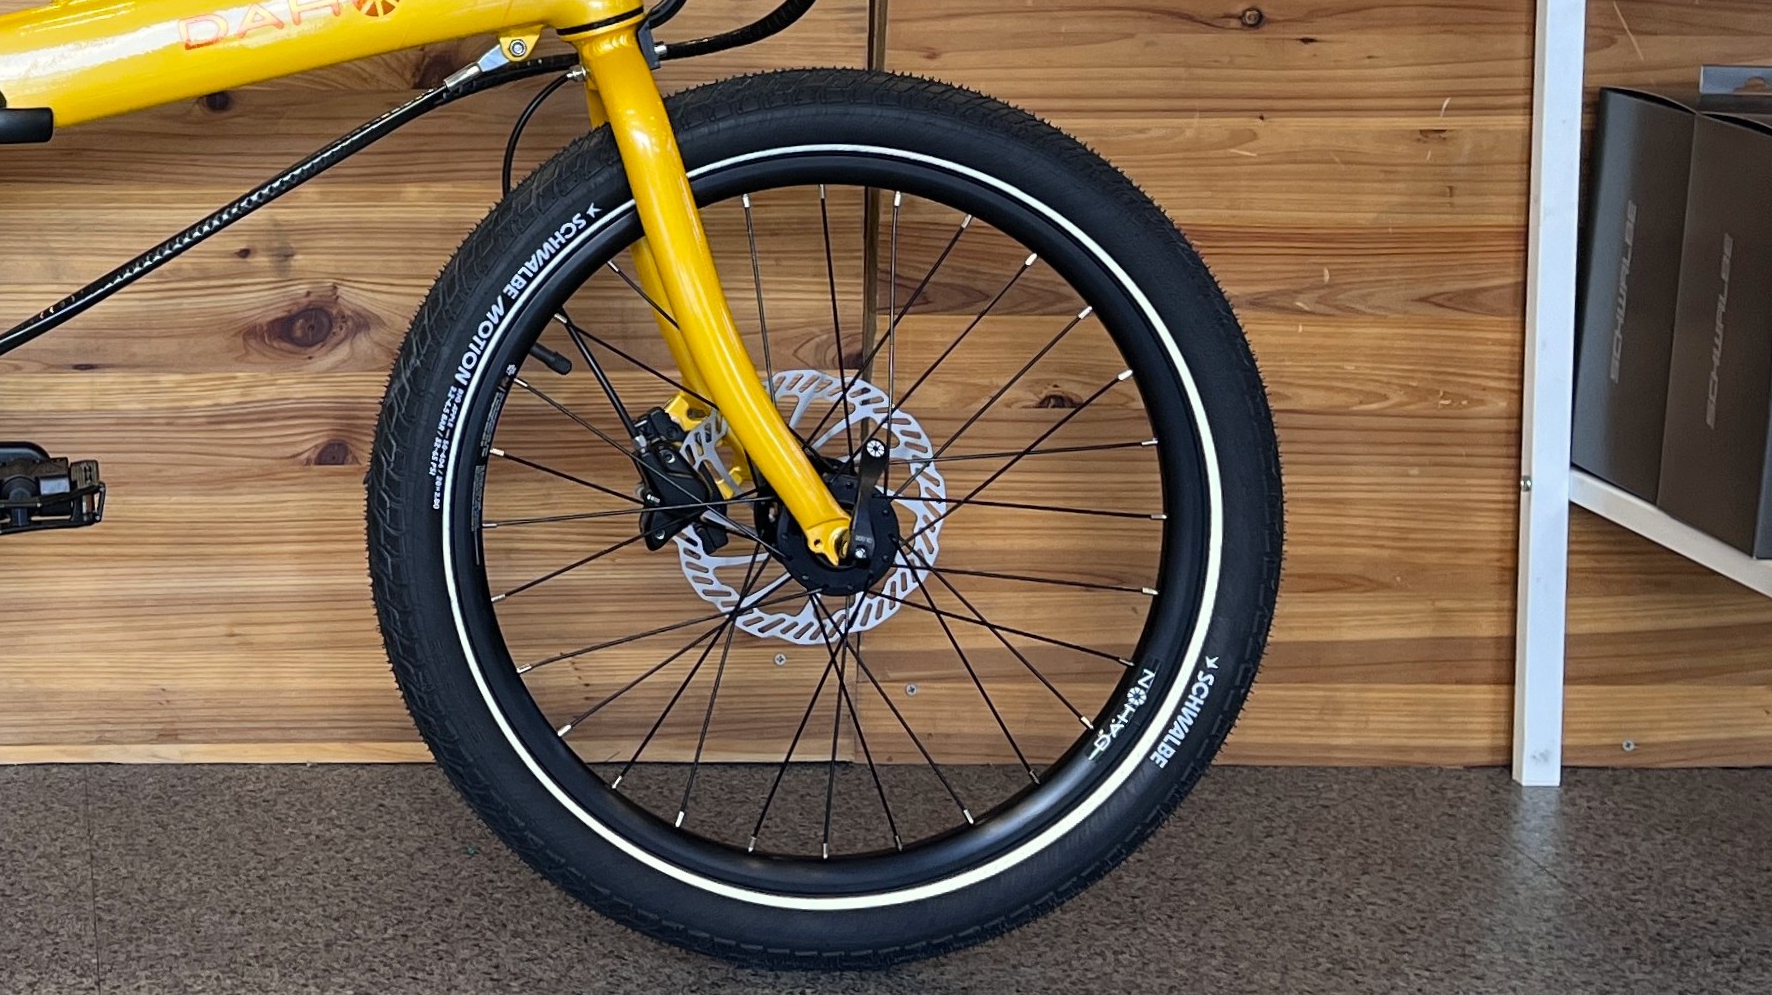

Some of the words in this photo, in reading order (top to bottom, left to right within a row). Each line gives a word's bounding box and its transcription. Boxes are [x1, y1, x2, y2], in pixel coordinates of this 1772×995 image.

[503, 213, 587, 300] SCHWALBE
[1610, 199, 1637, 385] SCHWALBE
[454, 295, 505, 386] MOTION
[1705, 232, 1733, 430] SCHWALBE
[1093, 669, 1156, 751] DAHON
[1150, 670, 1215, 769] SCHWALBE
